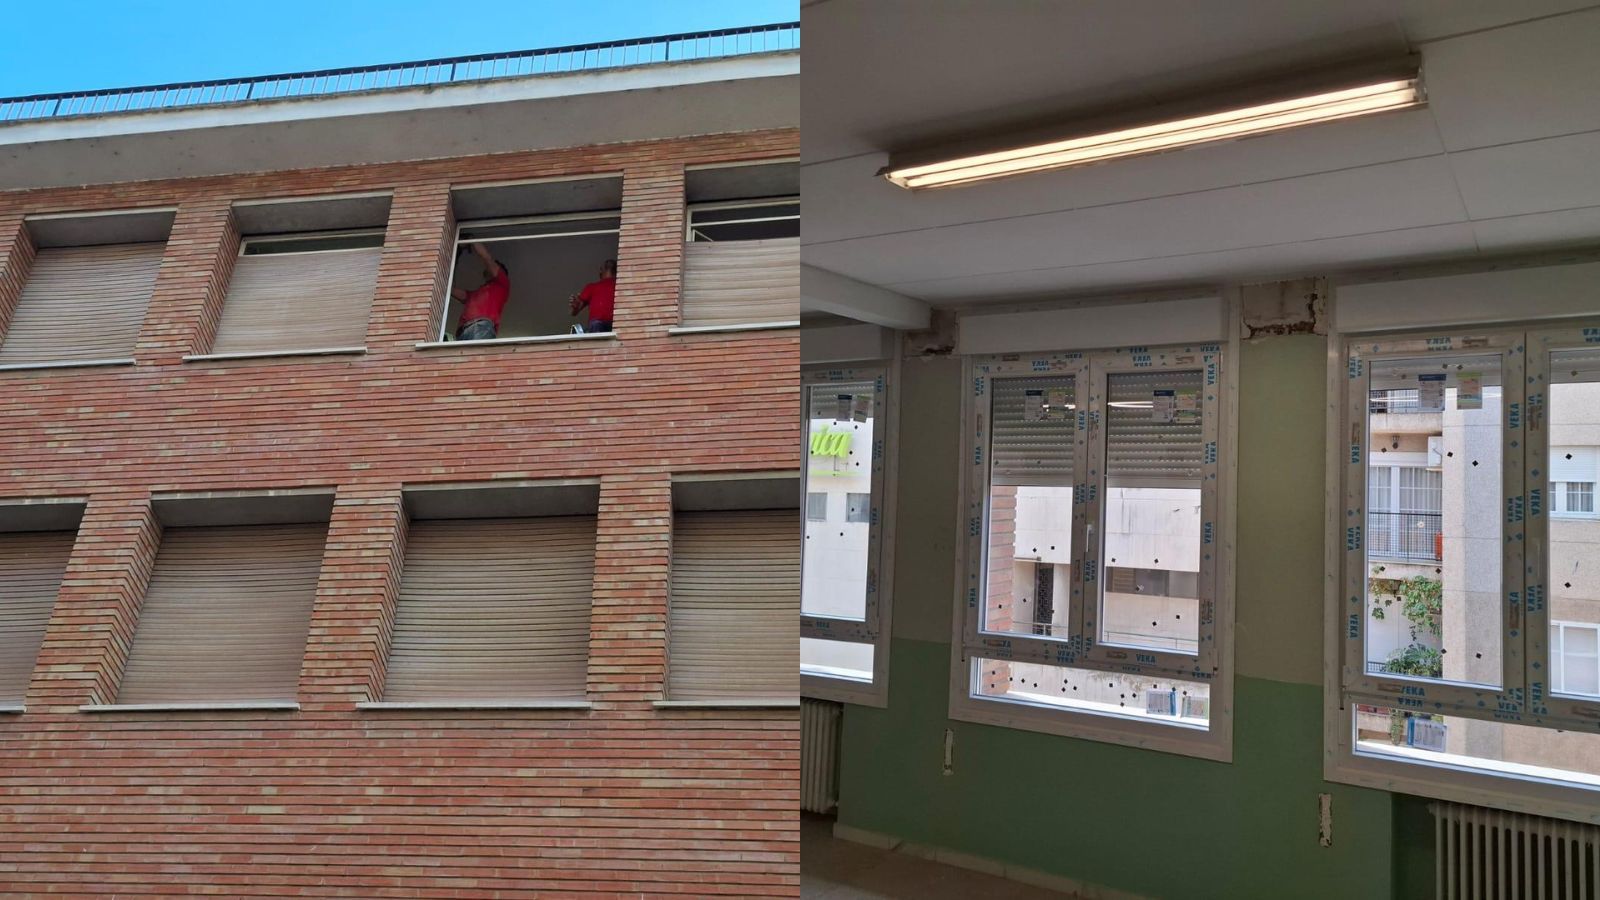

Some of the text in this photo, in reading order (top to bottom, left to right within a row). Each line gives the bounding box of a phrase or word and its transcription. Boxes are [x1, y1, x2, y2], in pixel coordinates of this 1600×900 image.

[1207, 363, 1215, 386] VEKA
[1509, 403, 1519, 429] VEKA
[1531, 489, 1541, 516] VEKA
[1350, 613, 1359, 638] VEKA
[1136, 653, 1157, 664] VEKA
